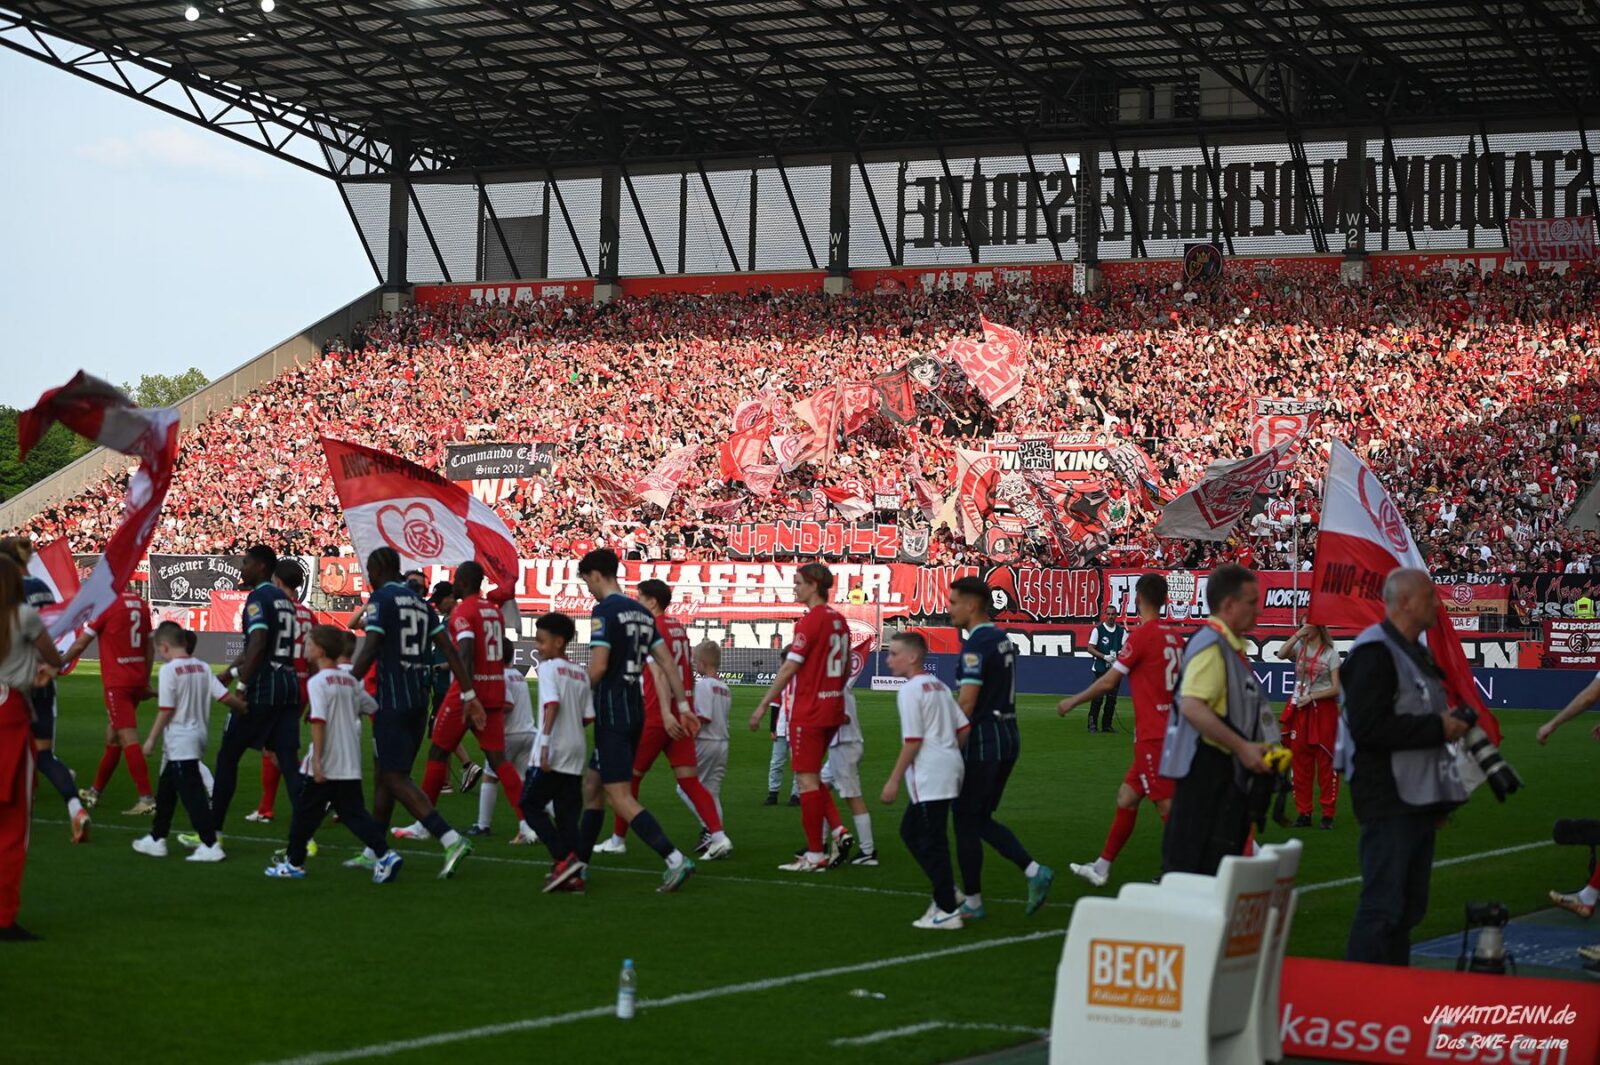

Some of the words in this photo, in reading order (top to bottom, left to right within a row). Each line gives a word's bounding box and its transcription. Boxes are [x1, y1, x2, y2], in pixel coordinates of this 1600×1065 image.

[1345, 212, 1361, 227] W
[600, 241, 611, 253] W
[829, 233, 842, 245] W
[1512, 240, 1593, 260] KASTEN
[451, 447, 513, 468] Commando
[475, 465, 500, 475] Since
[502, 464, 525, 474] 2012
[159, 560, 204, 580] Essener
[1018, 567, 1100, 620] ESSENER
[399, 608, 429, 656] 27
[1093, 943, 1179, 991] BECK
[1279, 1002, 1412, 1055] kasse
[1426, 1018, 1569, 1065] Essen
